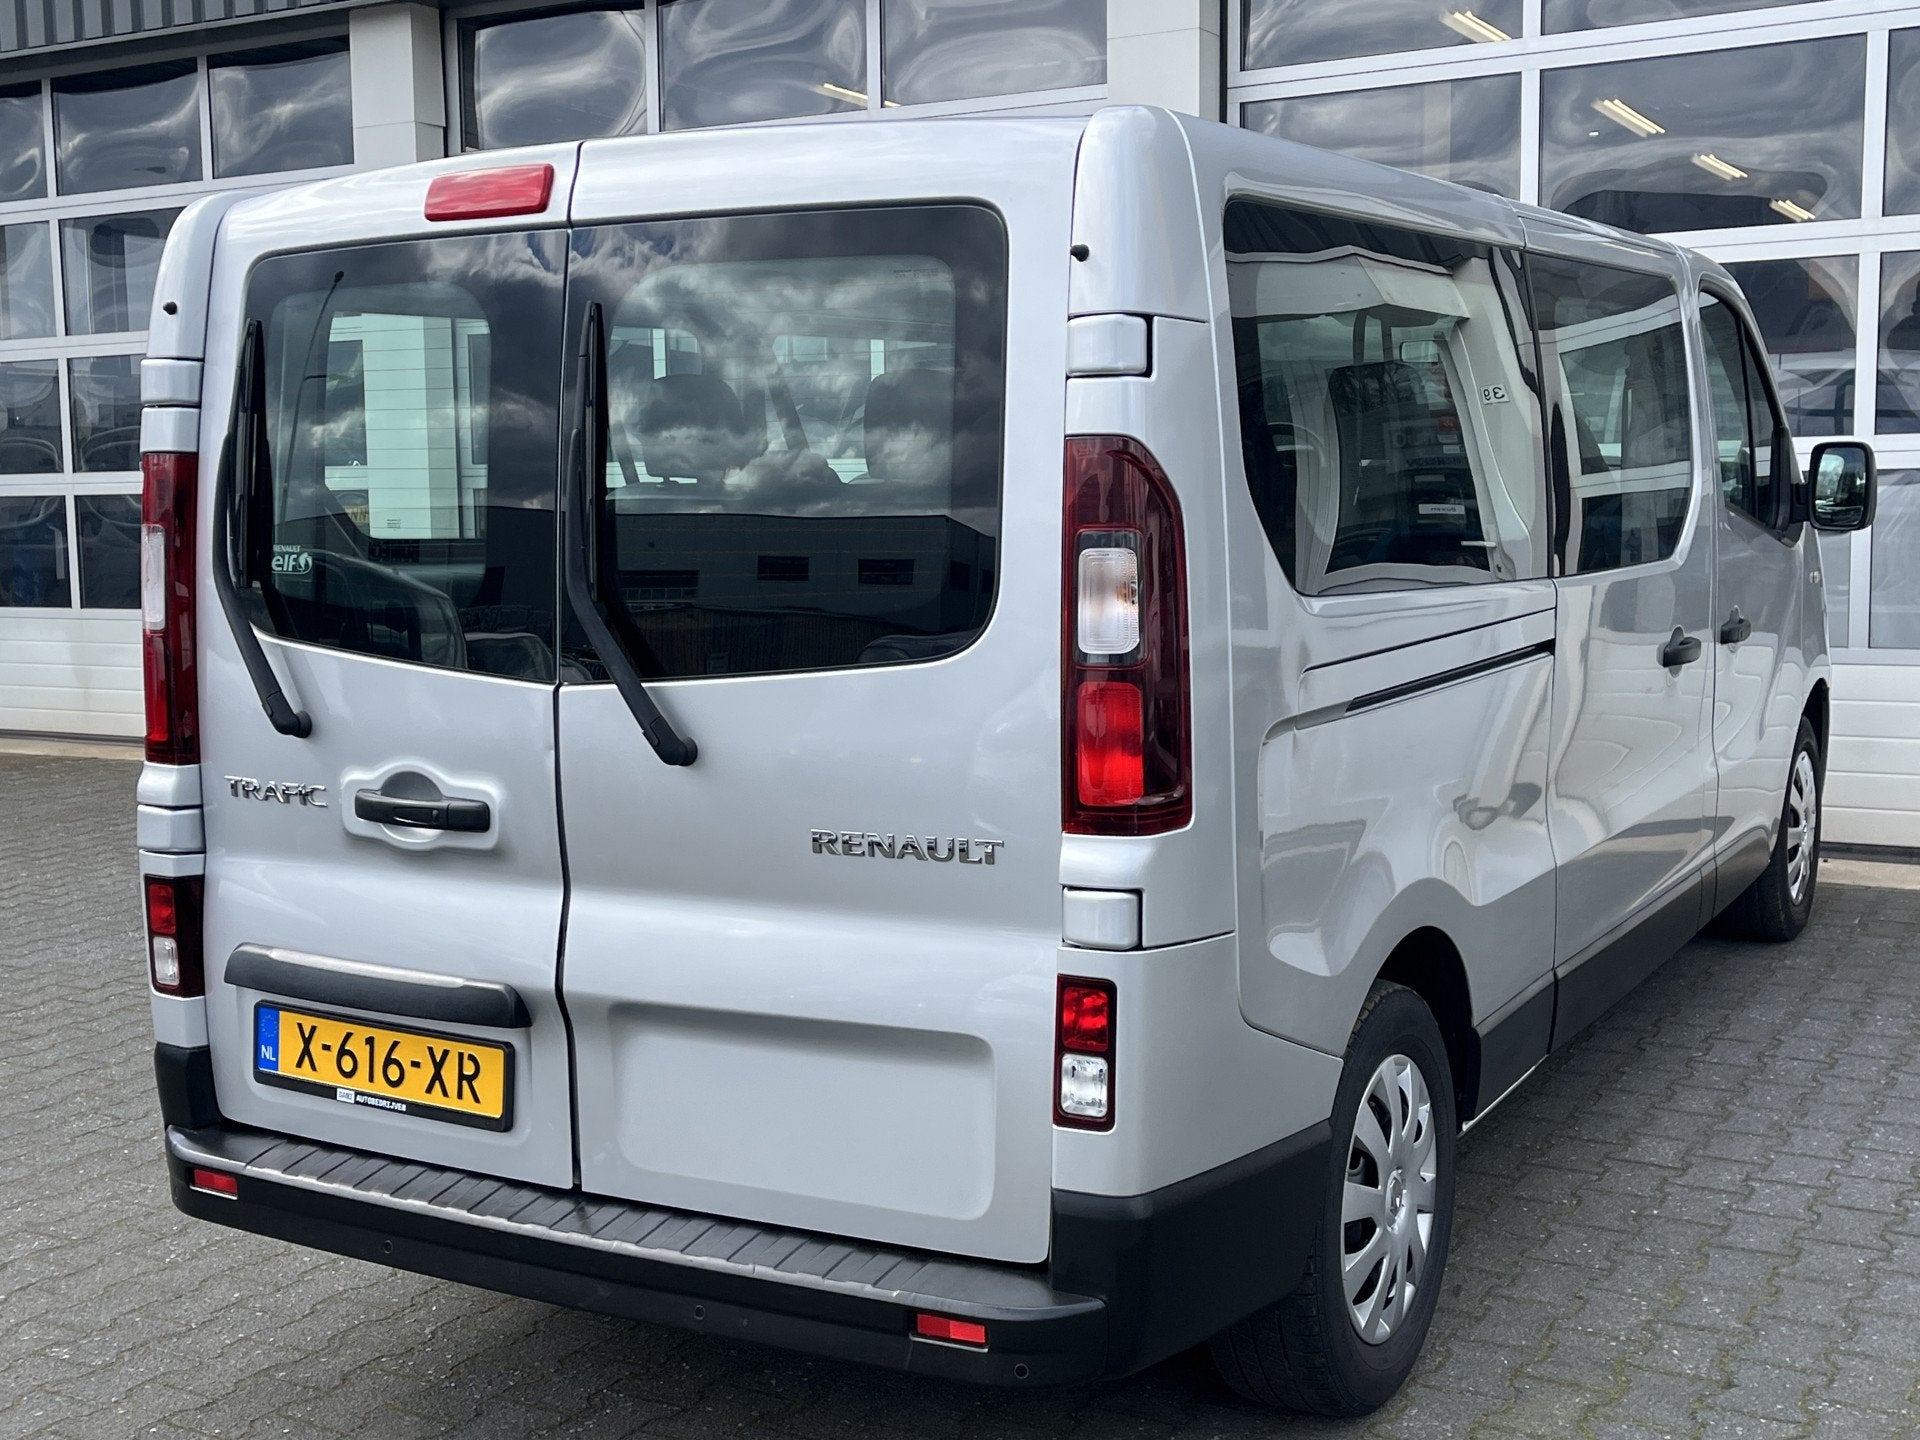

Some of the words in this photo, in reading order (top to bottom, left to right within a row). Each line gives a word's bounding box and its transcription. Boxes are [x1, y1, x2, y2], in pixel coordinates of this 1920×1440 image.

[271, 554, 298, 571] elf
[224, 775, 328, 808] TRAFIC
[810, 828, 1005, 865] RENAULT
[261, 1044, 277, 1062] NL
[295, 1022, 481, 1104] X-616-XR
